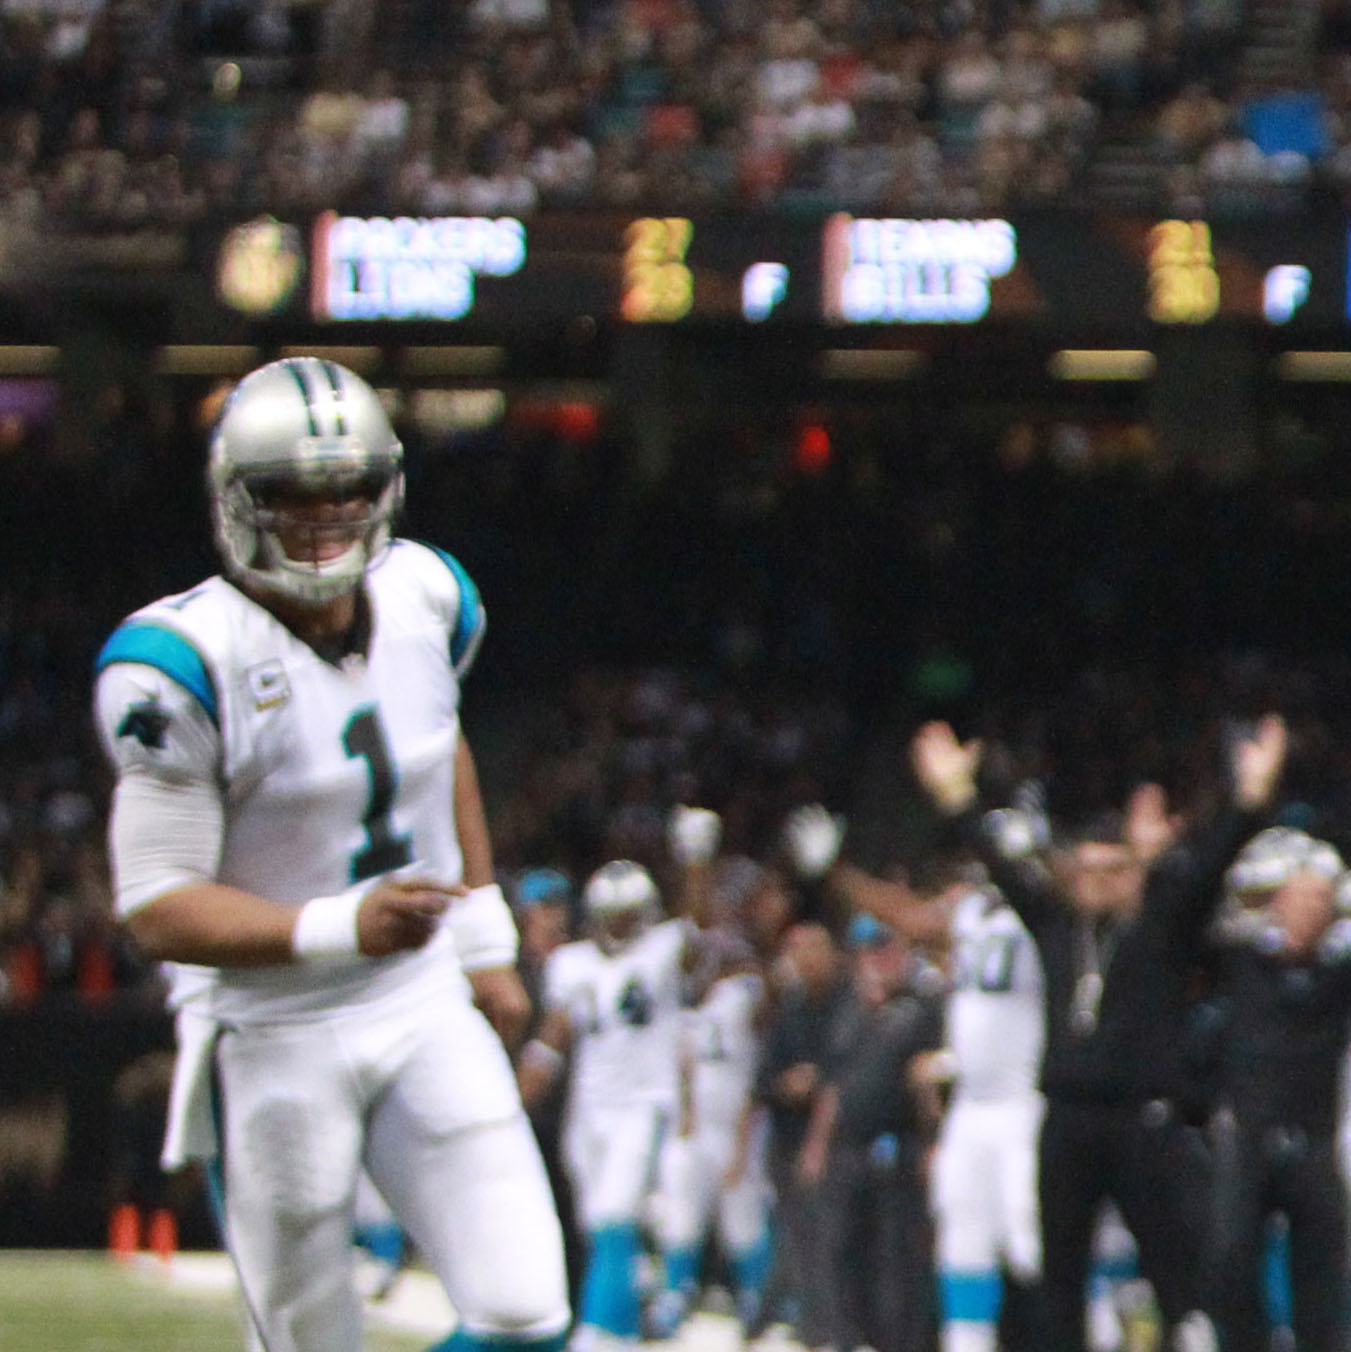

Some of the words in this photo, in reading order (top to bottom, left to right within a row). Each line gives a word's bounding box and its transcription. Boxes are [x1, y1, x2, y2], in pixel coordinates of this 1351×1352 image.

[333, 259, 470, 315] LIONS
[843, 263, 987, 318] BILLS
[340, 700, 414, 886] 1
